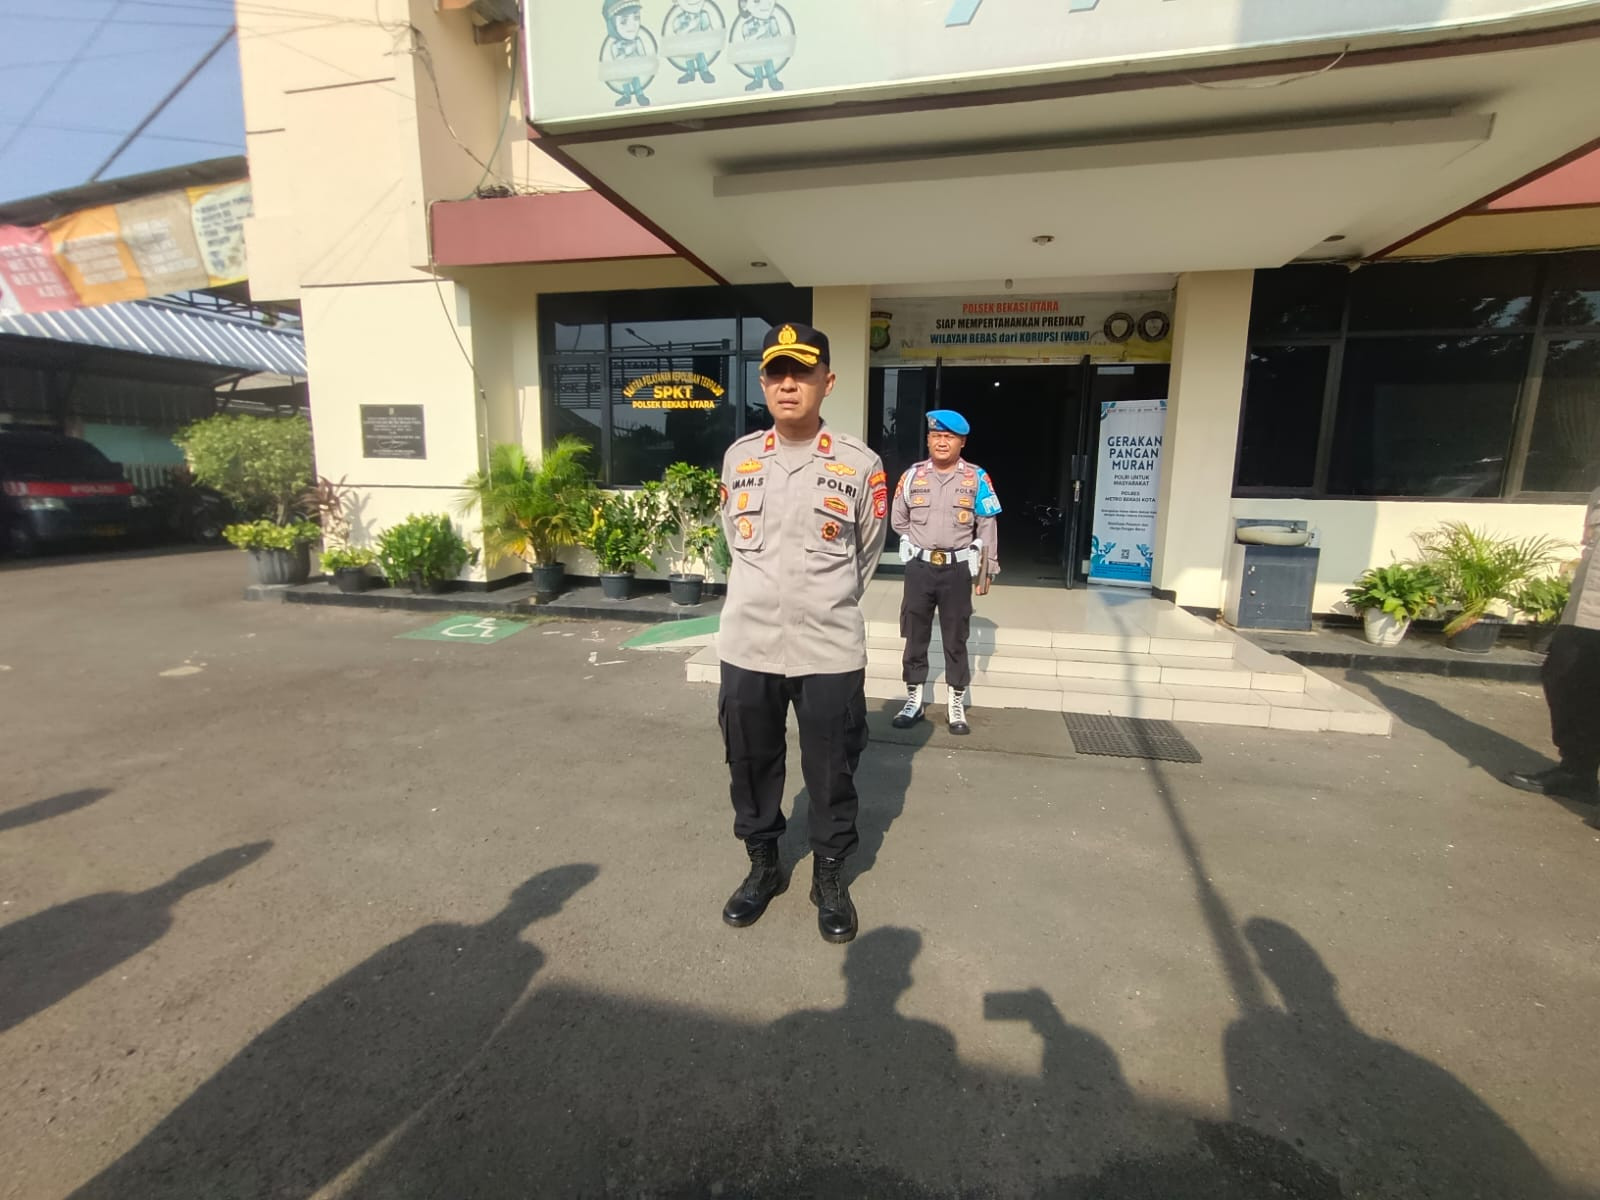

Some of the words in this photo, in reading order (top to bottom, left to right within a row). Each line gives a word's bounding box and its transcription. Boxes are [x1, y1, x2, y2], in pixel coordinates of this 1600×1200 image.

[963, 303, 994, 313] POLSEK
[996, 302, 1028, 313] BEKASI
[1031, 301, 1059, 312] UTARA
[936, 318, 956, 329] SIAP
[958, 317, 1039, 329] MEMPERTAHANKAN
[1042, 315, 1085, 327] PREDIKAT
[930, 333, 968, 344] WILAYAH
[969, 332, 998, 344] BEBAS
[999, 332, 1018, 343] dari
[1019, 331, 1059, 343] KORUPSI
[653, 385, 693, 399] SPKT
[632, 400, 660, 409] POLSEK
[661, 400, 688, 409] BEKASI
[689, 400, 715, 409] UTARA
[1107, 436, 1163, 447] GERAKAN
[1109, 448, 1159, 459] PANGAN
[1112, 460, 1154, 471] MURAH
[817, 477, 857, 498] POLRI
